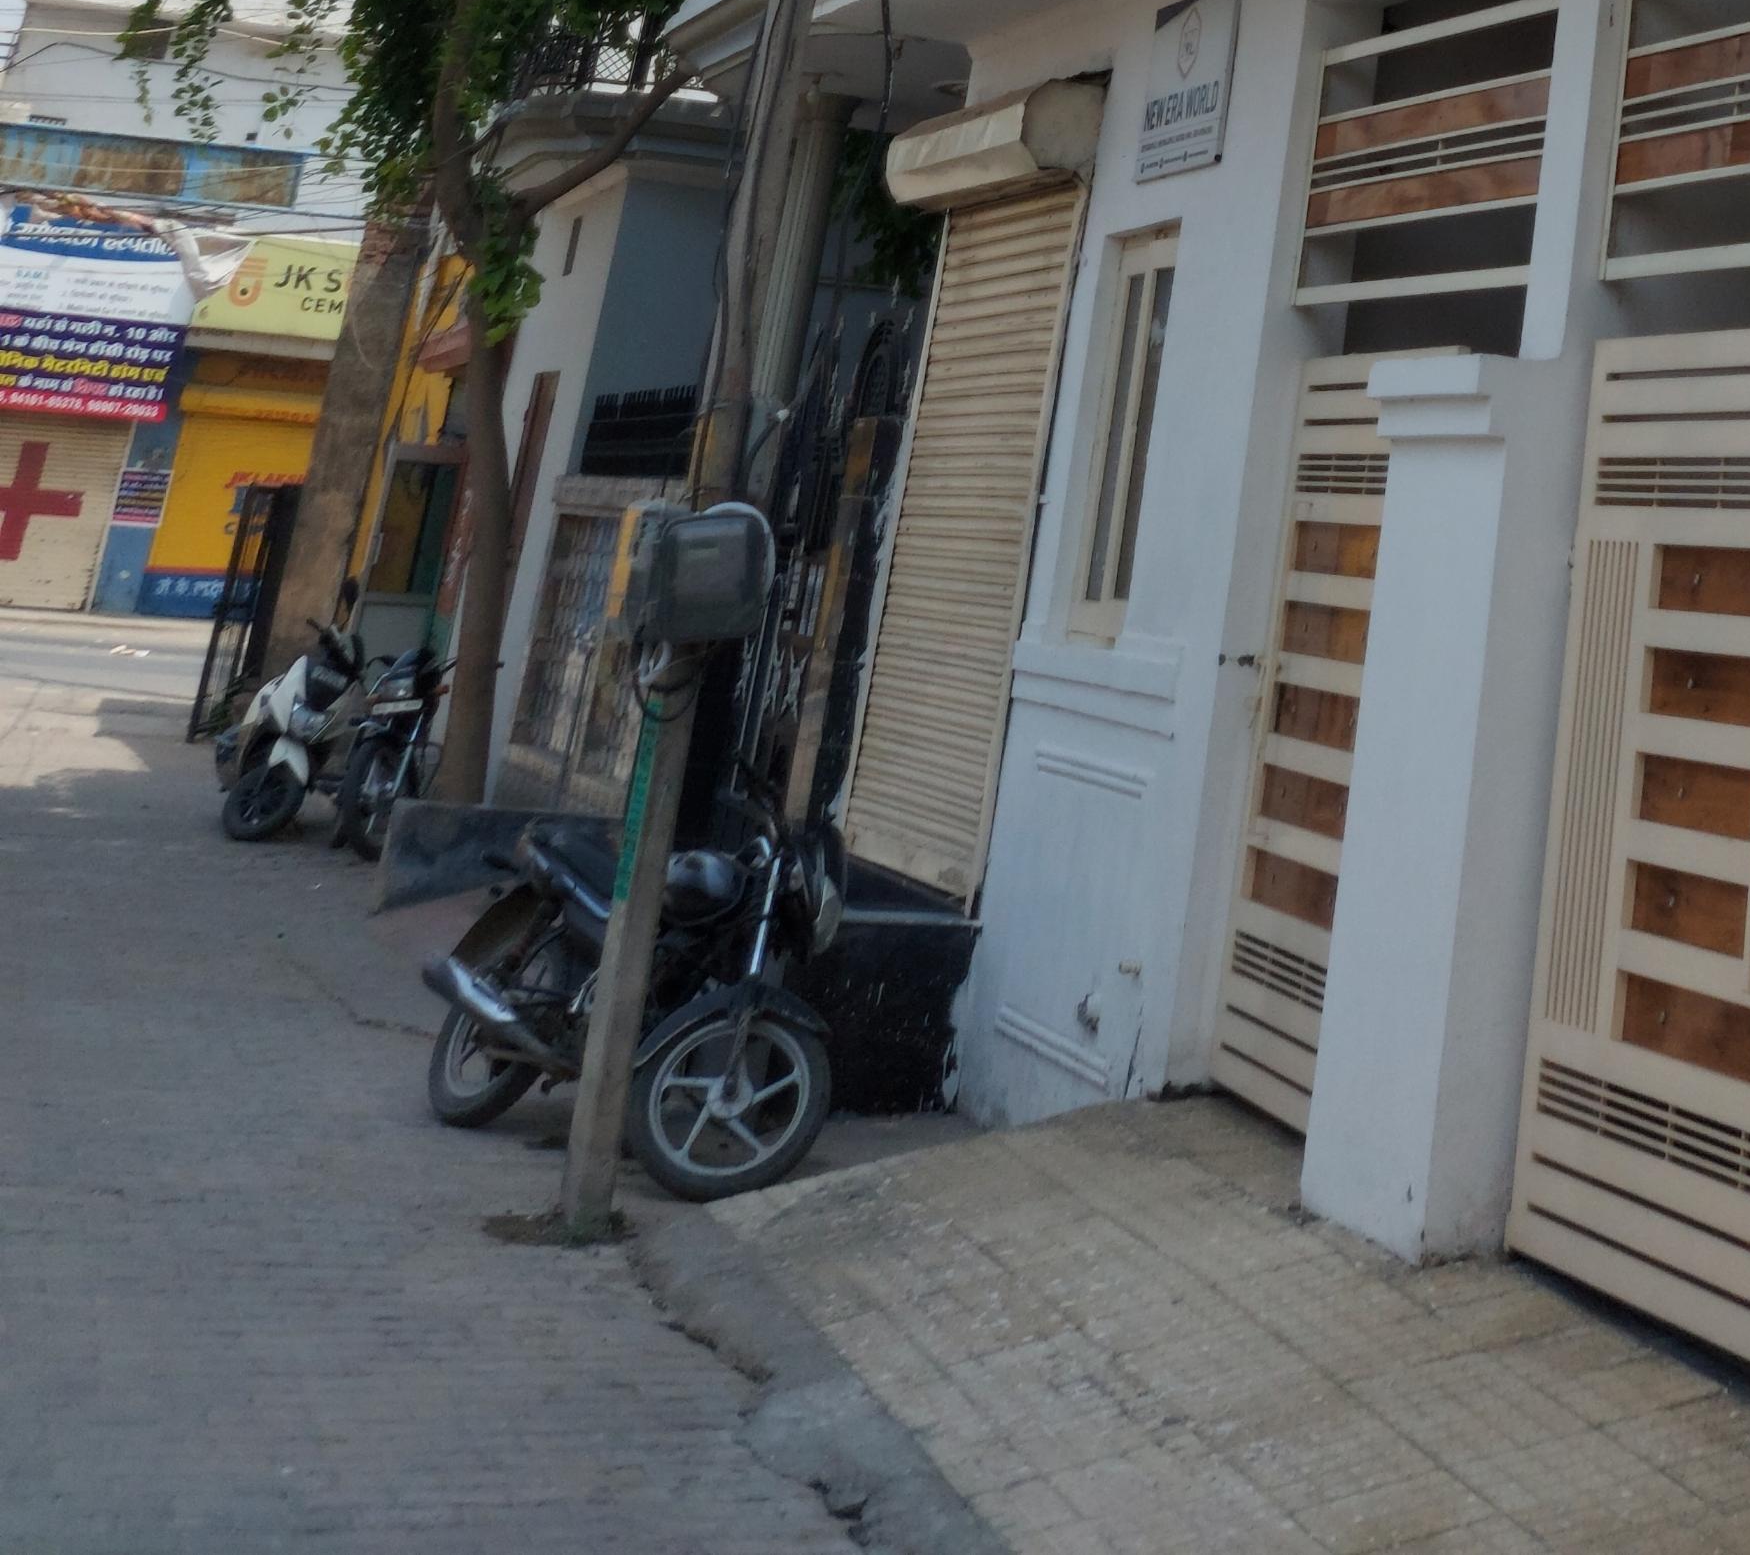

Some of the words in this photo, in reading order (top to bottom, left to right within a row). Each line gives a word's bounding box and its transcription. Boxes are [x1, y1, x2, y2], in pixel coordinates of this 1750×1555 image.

[1144, 97, 1166, 132] NEW
[1165, 92, 1184, 125] ERA
[1185, 80, 1219, 119] WORLD
[274, 264, 317, 291] JK
[301, 296, 344, 315] CEM
[127, 327, 147, 340] 10
